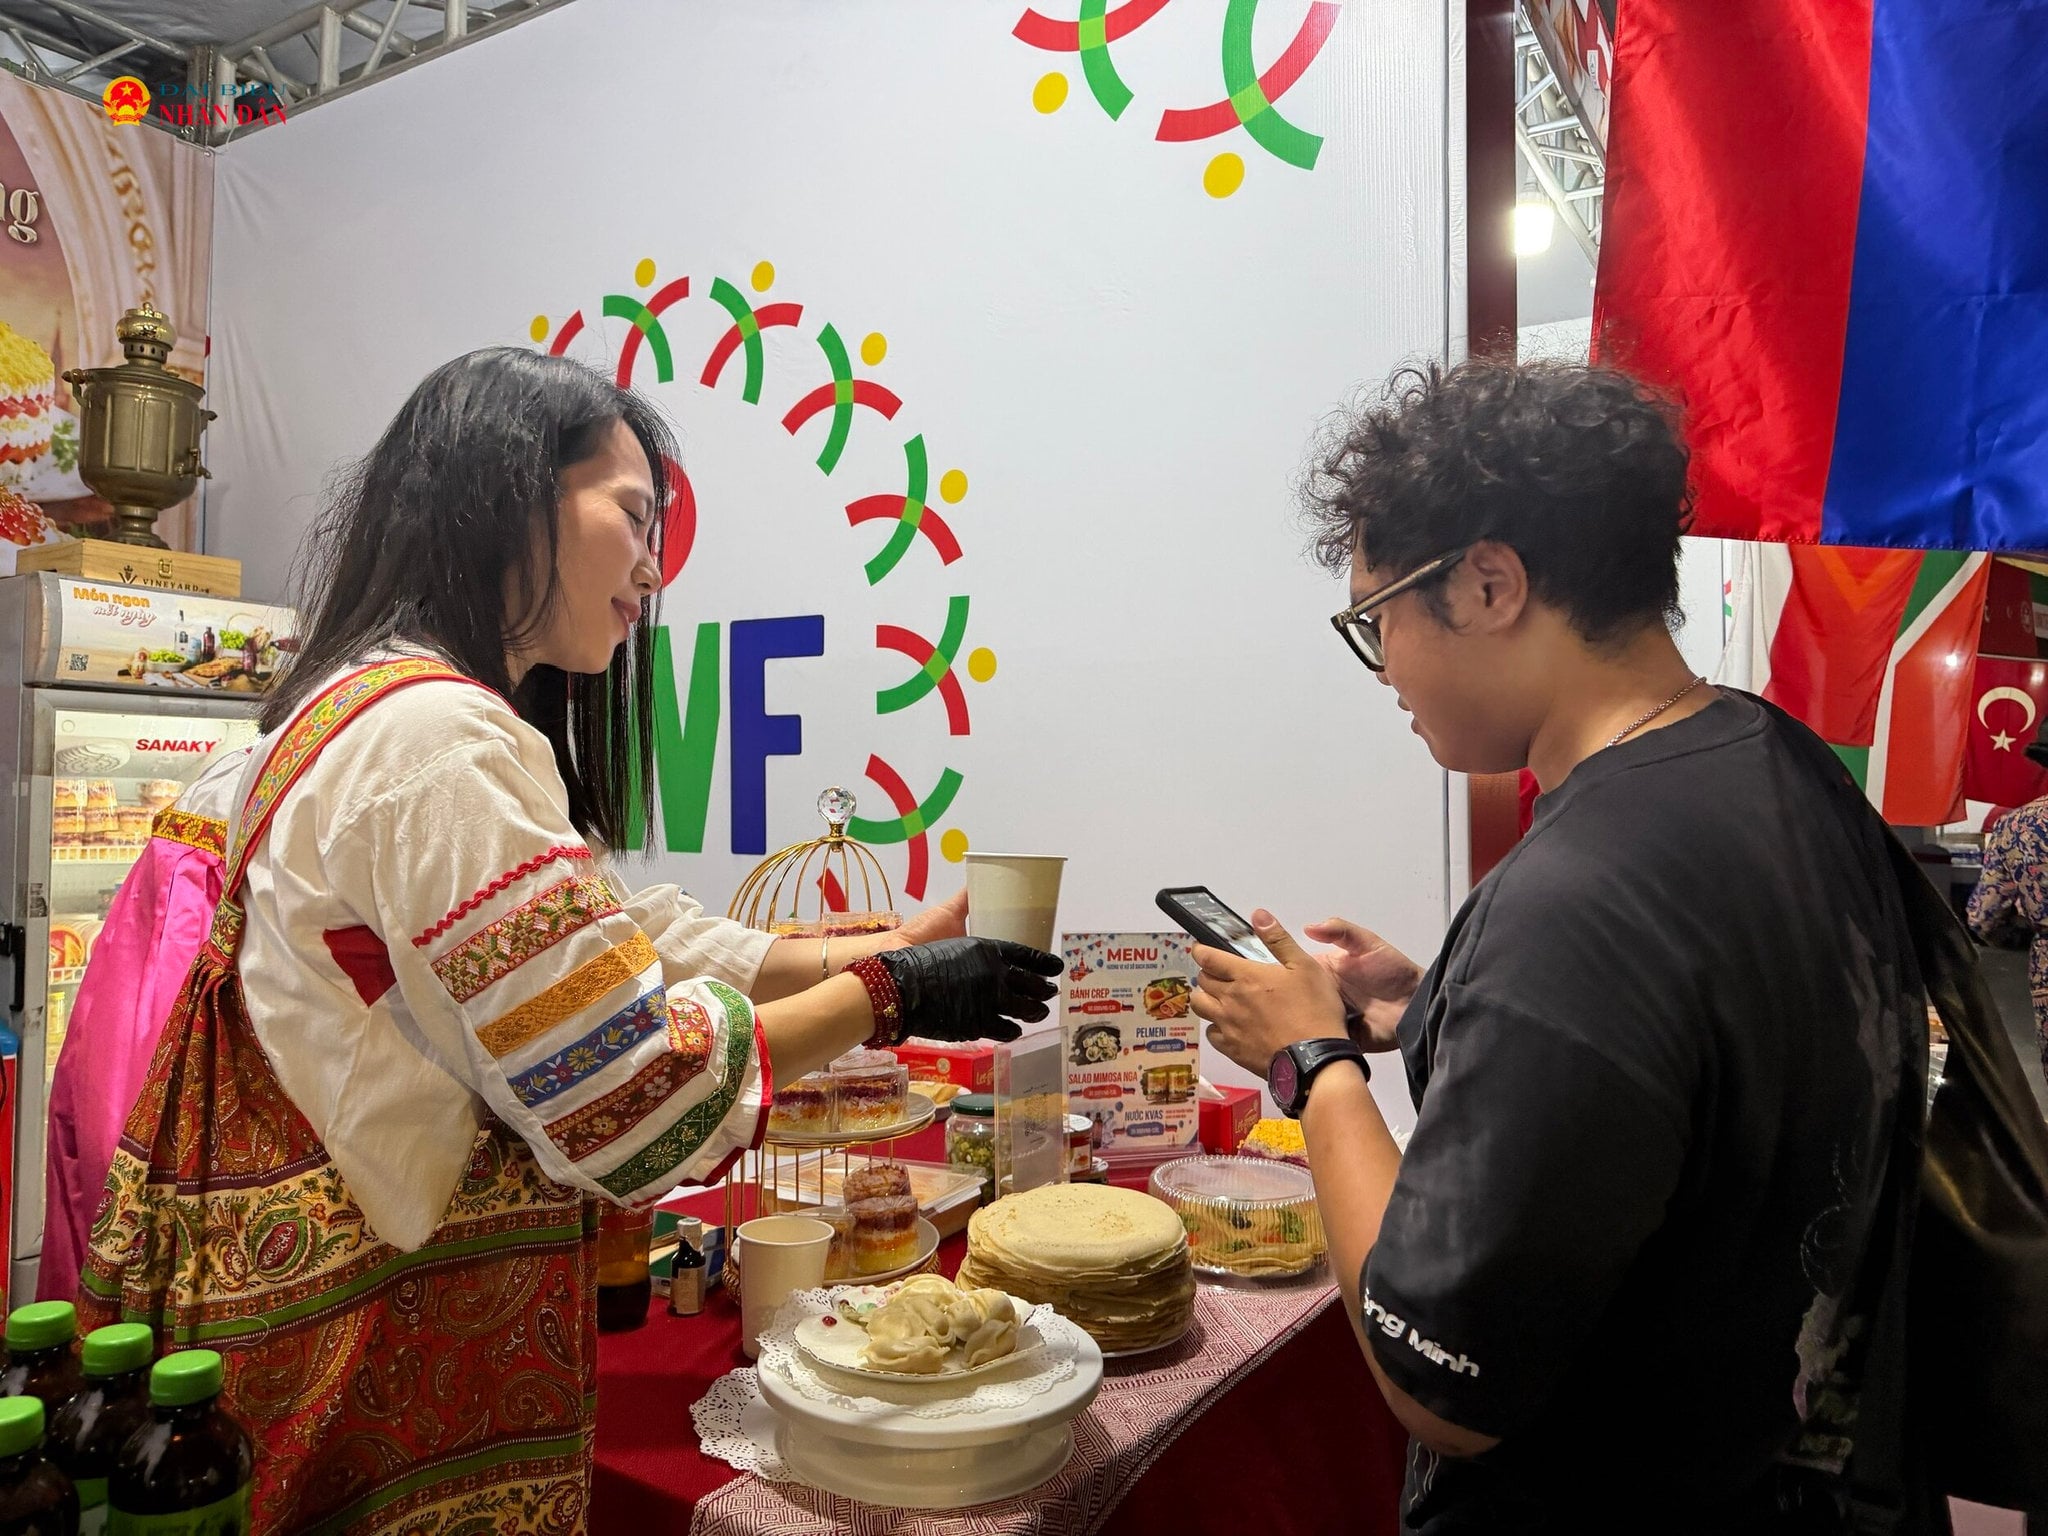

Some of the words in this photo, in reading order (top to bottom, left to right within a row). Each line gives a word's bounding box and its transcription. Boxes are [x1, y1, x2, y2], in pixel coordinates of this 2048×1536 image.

[73, 587, 110, 604] Món
[113, 593, 151, 608] ngon
[136, 738, 217, 752] SANAKY
[1107, 947, 1159, 962] MENU
[1070, 986, 1090, 999] BÁNH
[1091, 987, 1110, 999] CREP
[1135, 1026, 1167, 1038] PELMENI
[1068, 1073, 1092, 1085] SALAD
[1093, 1071, 1123, 1083] MIMOSA
[1123, 1070, 1138, 1082] NGA
[1144, 1109, 1164, 1121] KVAS
[1408, 1328, 1480, 1378] Minh
